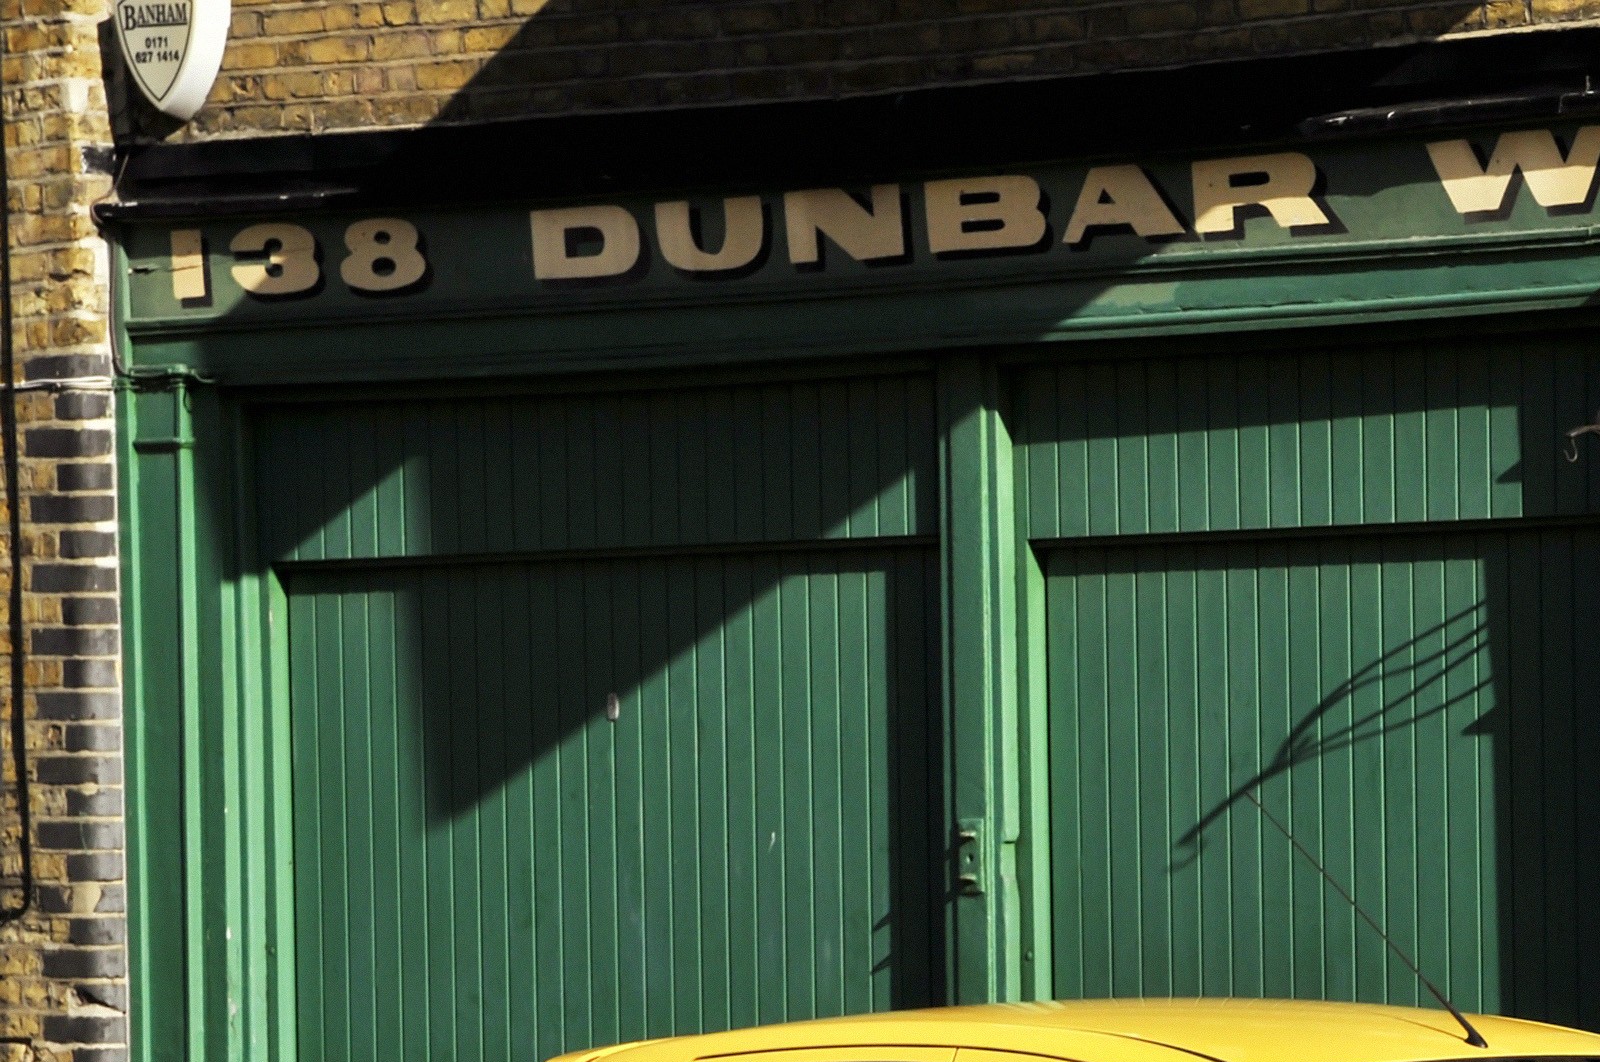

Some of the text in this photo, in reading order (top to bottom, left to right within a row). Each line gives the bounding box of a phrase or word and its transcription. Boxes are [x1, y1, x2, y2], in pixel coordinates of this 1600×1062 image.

[123, 3, 187, 31] BANHAM
[144, 36, 168, 49] 0171
[157, 49, 180, 62] 1414
[170, 220, 425, 300] 138
[531, 153, 1329, 279] DUNBAR
